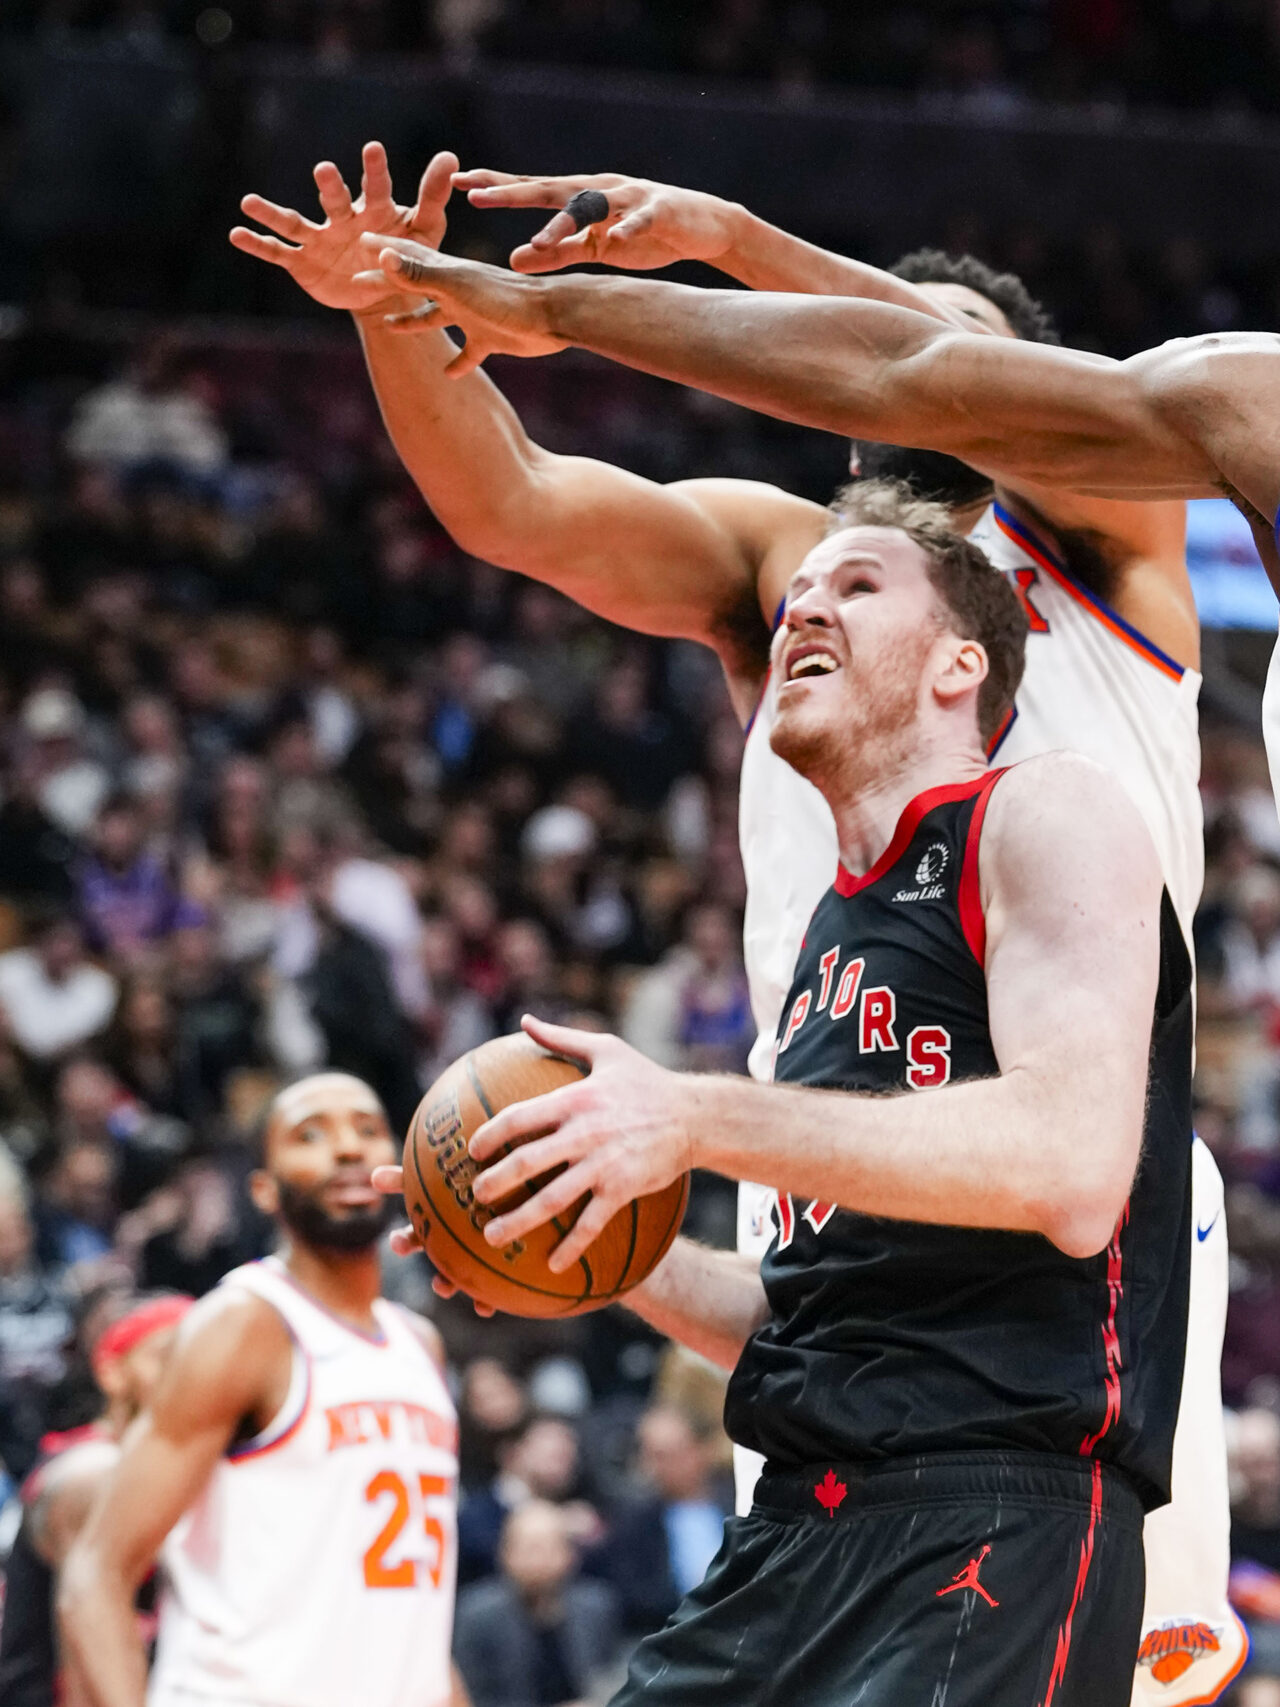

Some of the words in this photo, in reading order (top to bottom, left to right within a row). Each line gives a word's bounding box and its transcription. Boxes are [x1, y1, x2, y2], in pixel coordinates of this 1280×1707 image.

[891, 889, 920, 902] Sun
[919, 883, 946, 900] Life
[363, 1469, 448, 1588] 25
[1137, 1622, 1221, 1661] KNICKS
